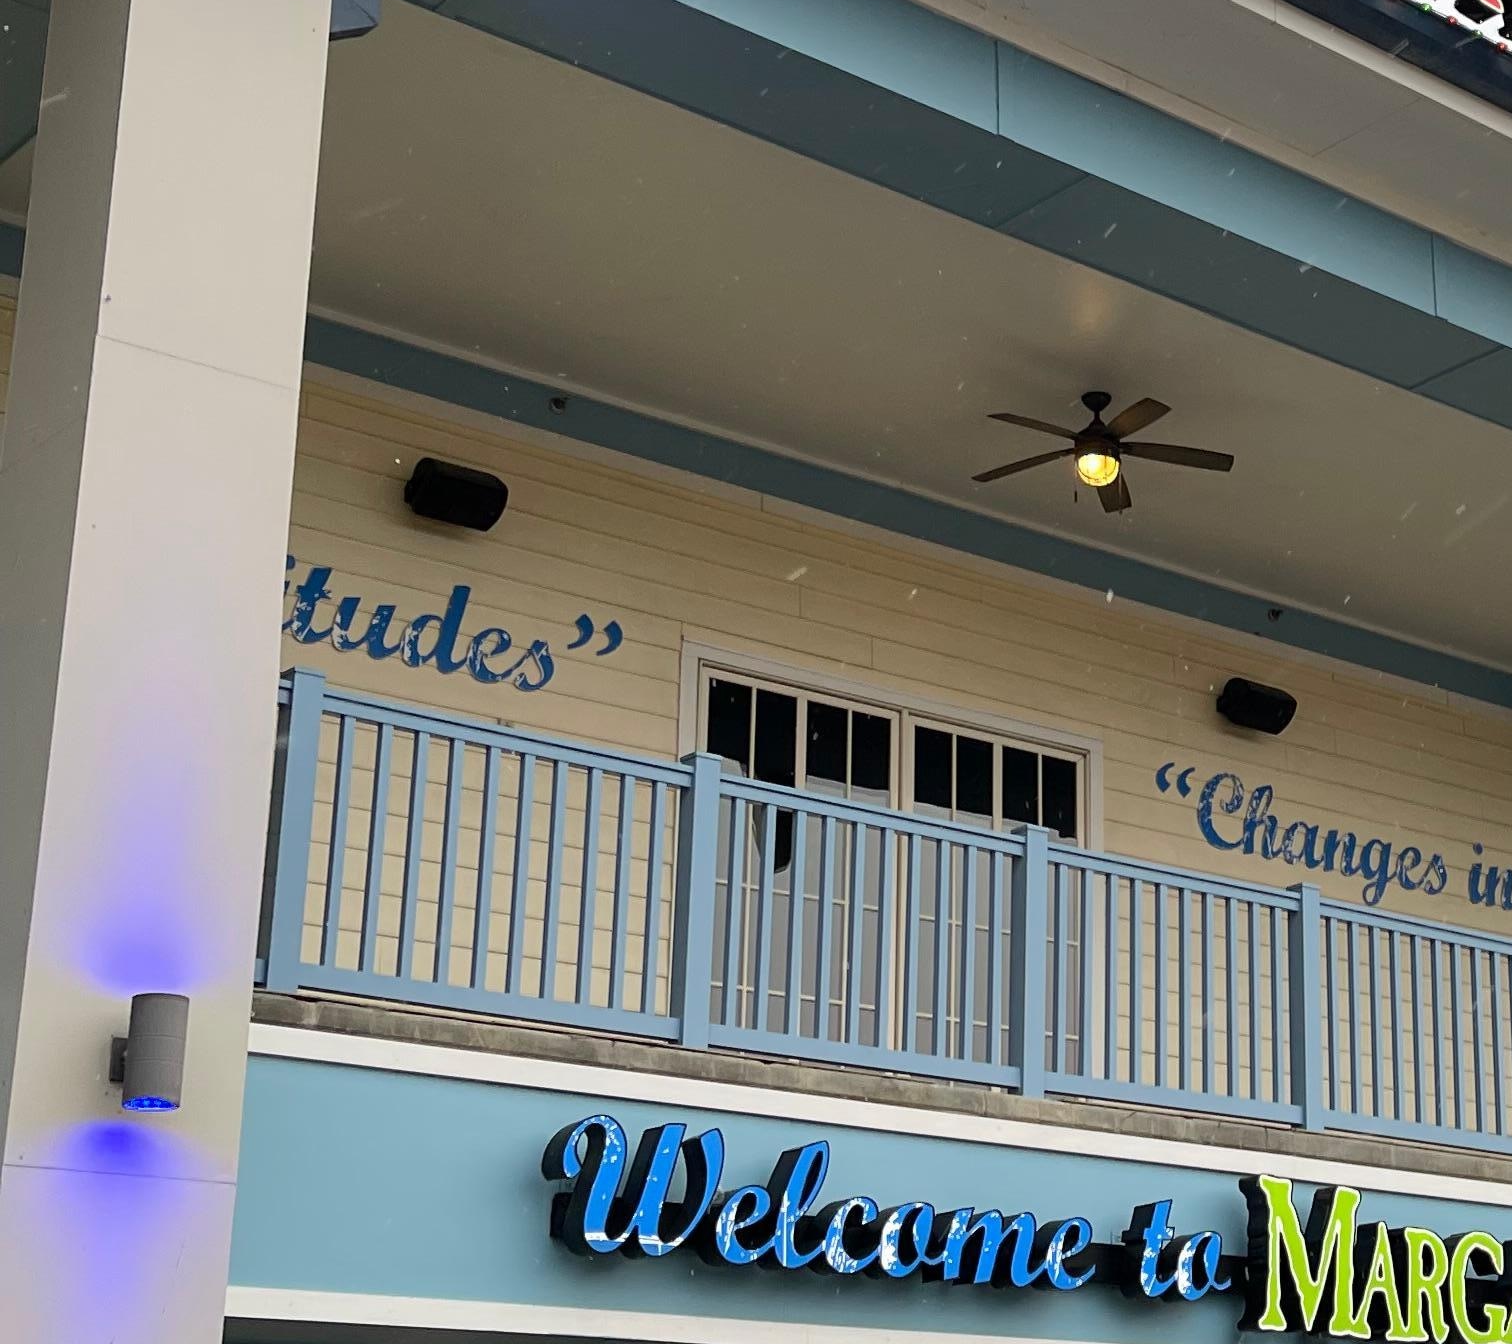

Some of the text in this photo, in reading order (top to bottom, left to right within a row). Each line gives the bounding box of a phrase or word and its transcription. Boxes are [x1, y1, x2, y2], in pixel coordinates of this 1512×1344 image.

[281, 554, 624, 693] tudes”
[542, 1114, 1096, 1291] Welcome
[1125, 1196, 1233, 1302] to
